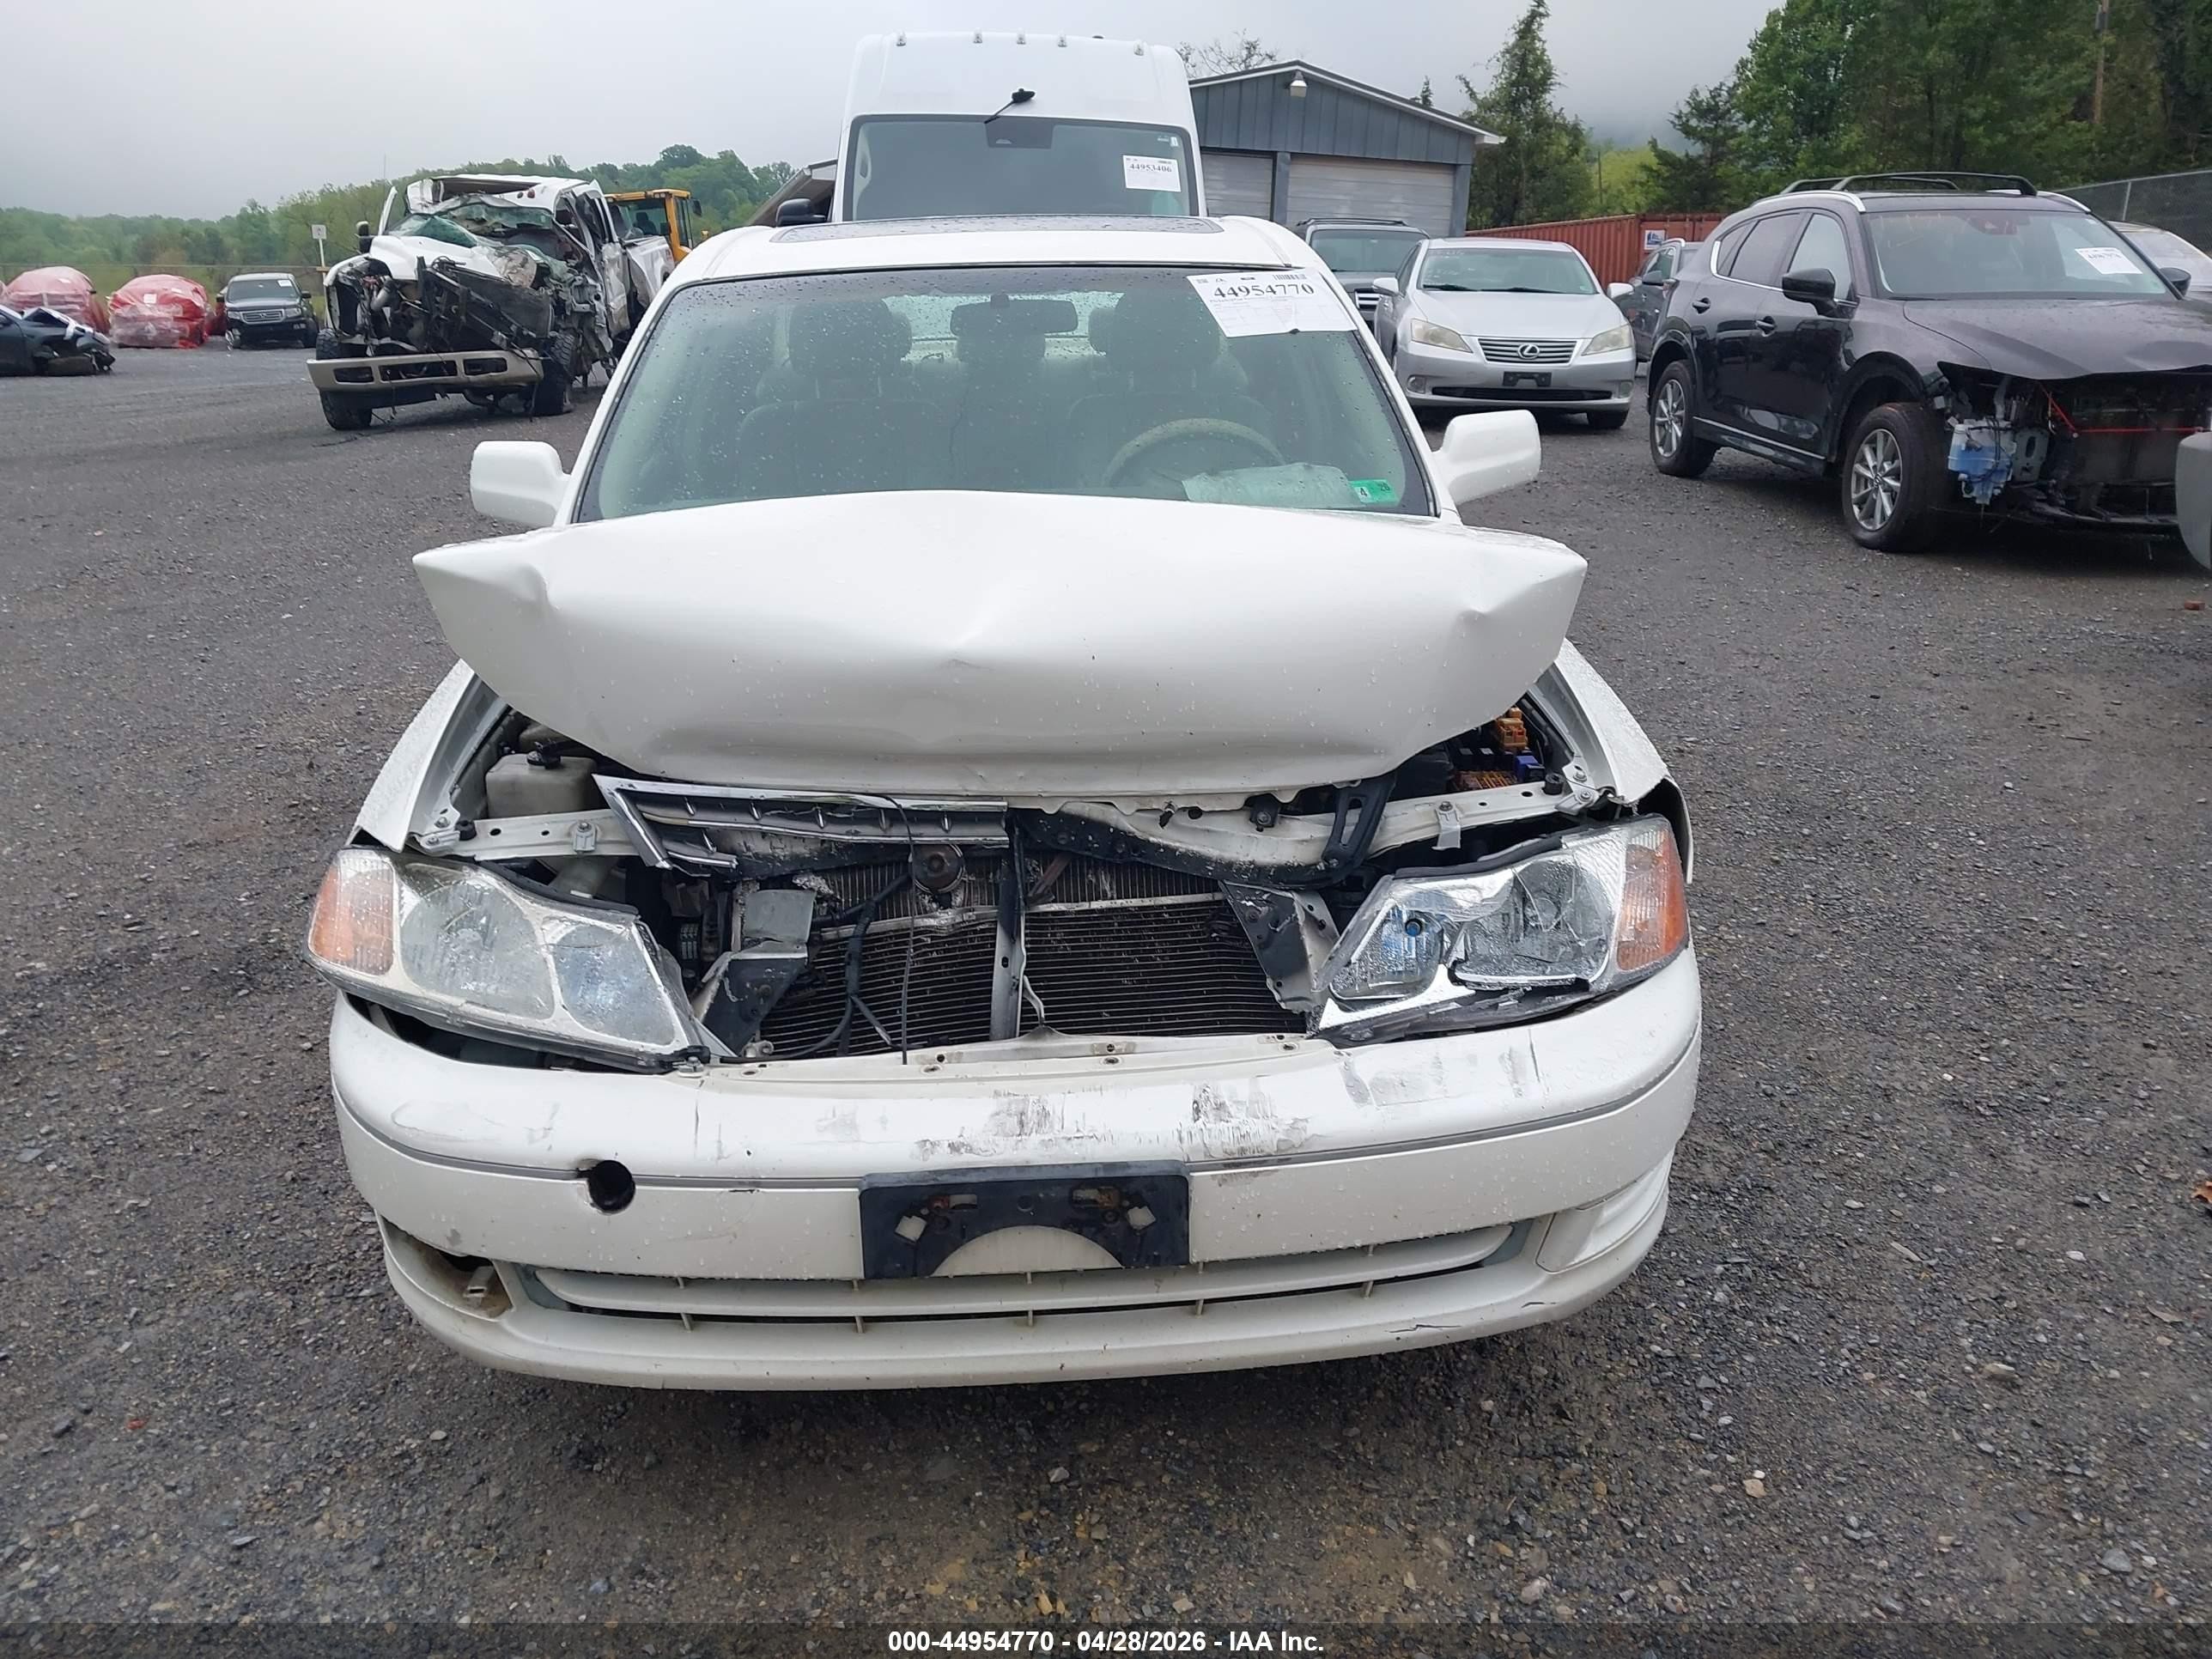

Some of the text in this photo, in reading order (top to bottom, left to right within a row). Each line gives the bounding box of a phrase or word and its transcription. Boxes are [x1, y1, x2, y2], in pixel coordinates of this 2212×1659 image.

[1129, 163, 1172, 173] 44953406
[1213, 283, 1315, 298] 44954770
[1359, 487, 1368, 497] 4
